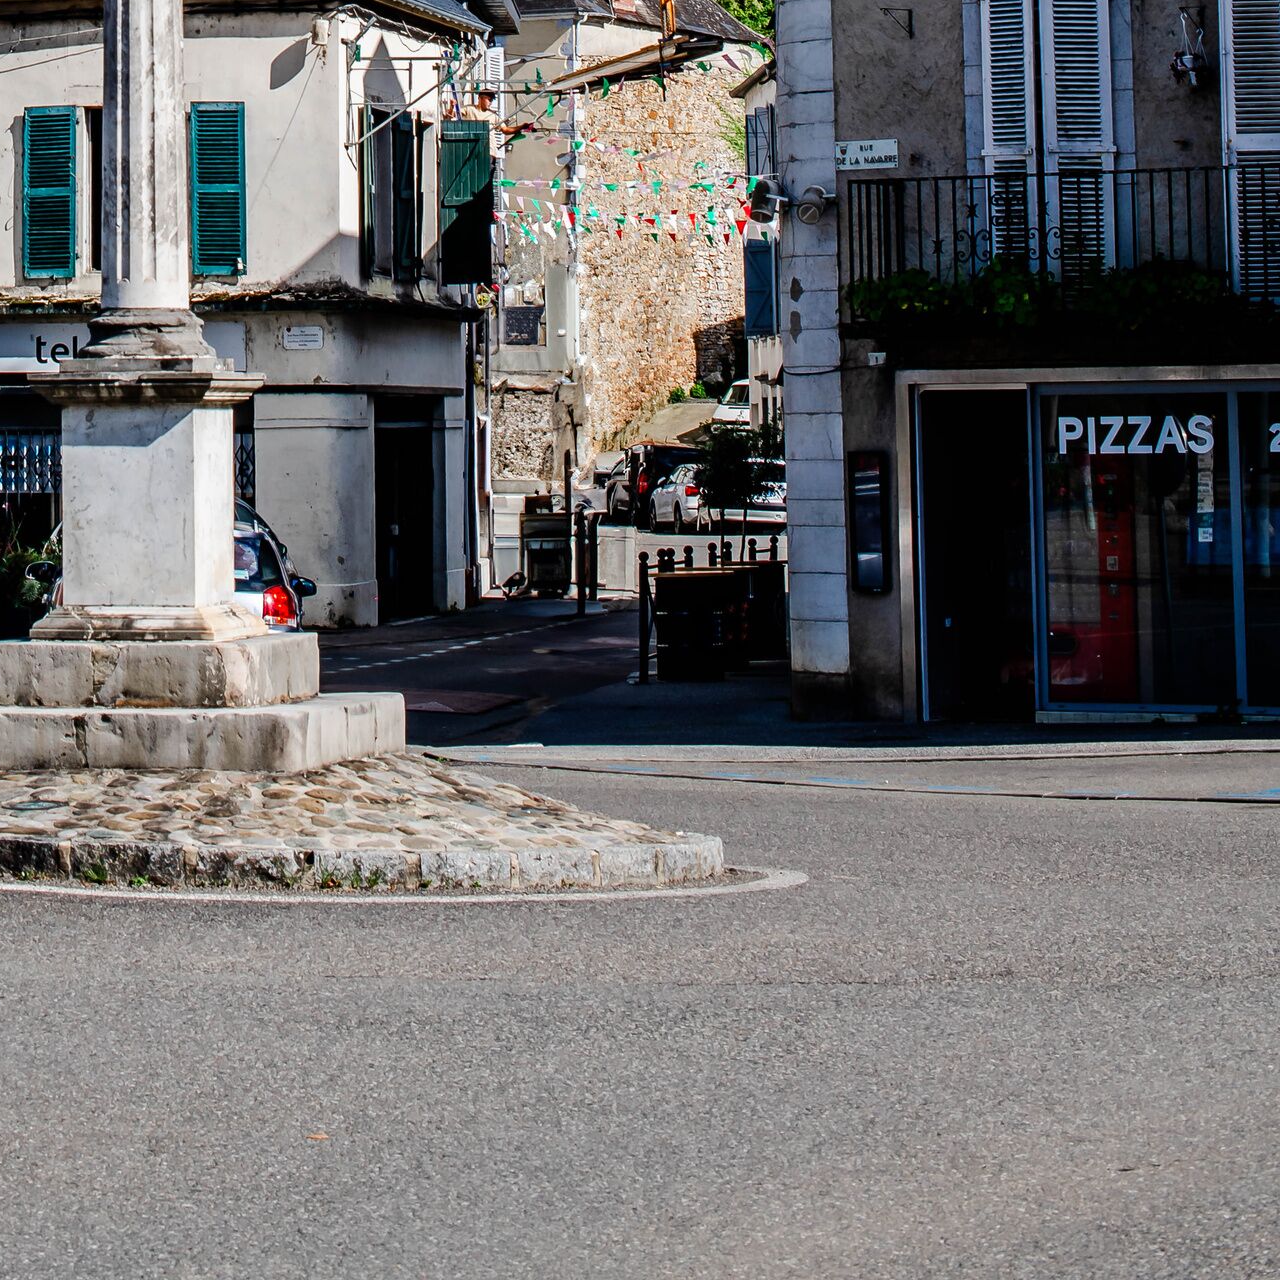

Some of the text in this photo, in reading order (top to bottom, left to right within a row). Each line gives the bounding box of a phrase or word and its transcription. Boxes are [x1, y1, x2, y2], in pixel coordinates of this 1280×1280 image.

[859, 144, 874, 152] RUE
[836, 154, 898, 166] DE LA NAVARRE
[1058, 415, 1215, 455] PIZZAS
